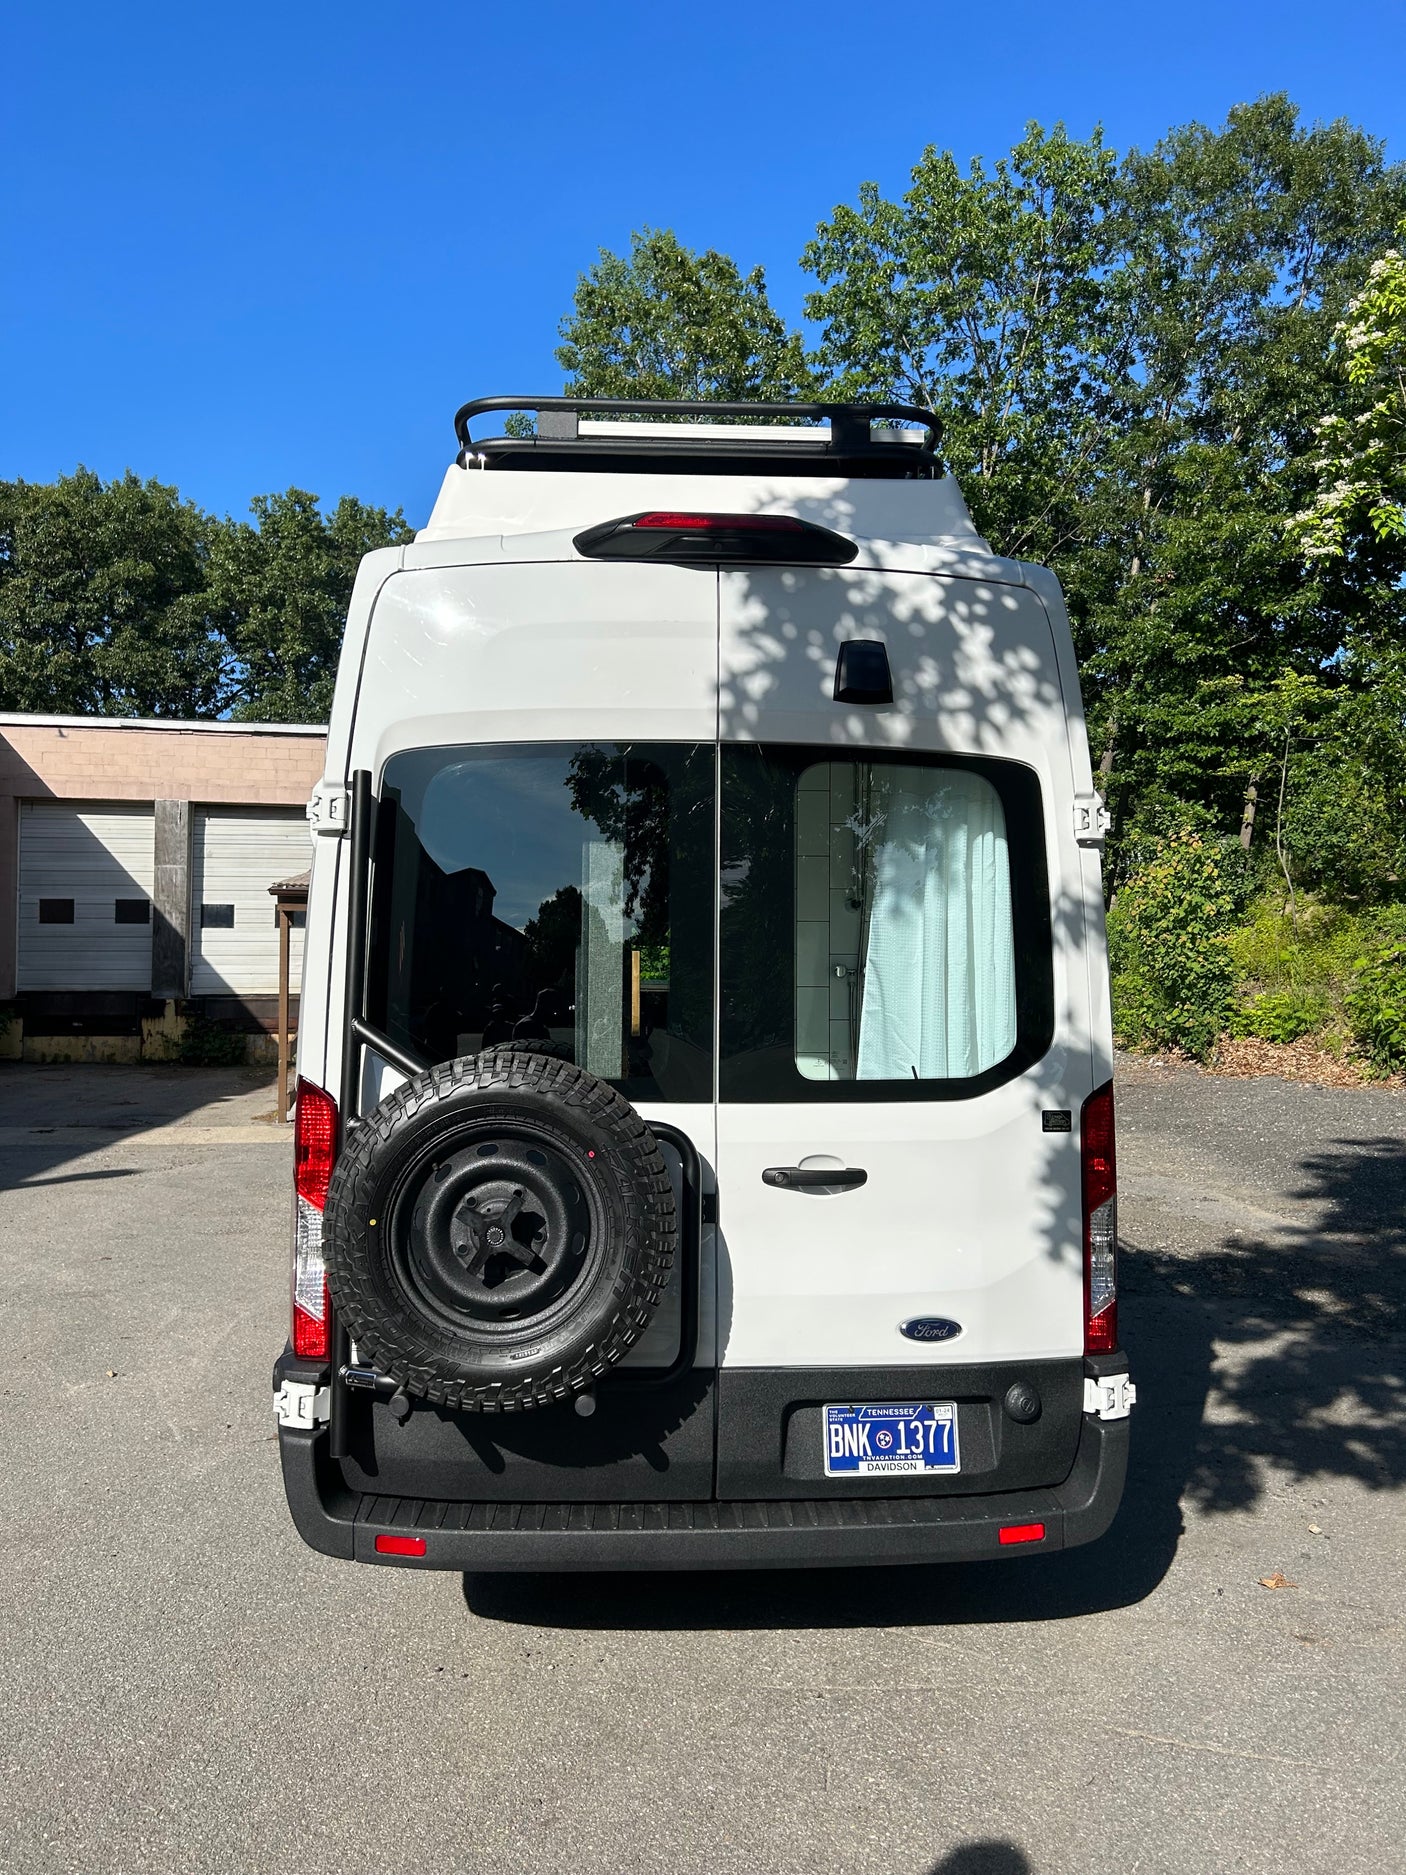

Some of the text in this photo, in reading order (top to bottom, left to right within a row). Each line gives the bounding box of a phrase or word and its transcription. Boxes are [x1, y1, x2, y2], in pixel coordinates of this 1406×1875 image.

[915, 1323, 949, 1337] Ford
[867, 1408, 915, 1416] TENNESSEE
[830, 1420, 952, 1457] BNK 1377
[867, 1462, 917, 1471] DAVIDSON
